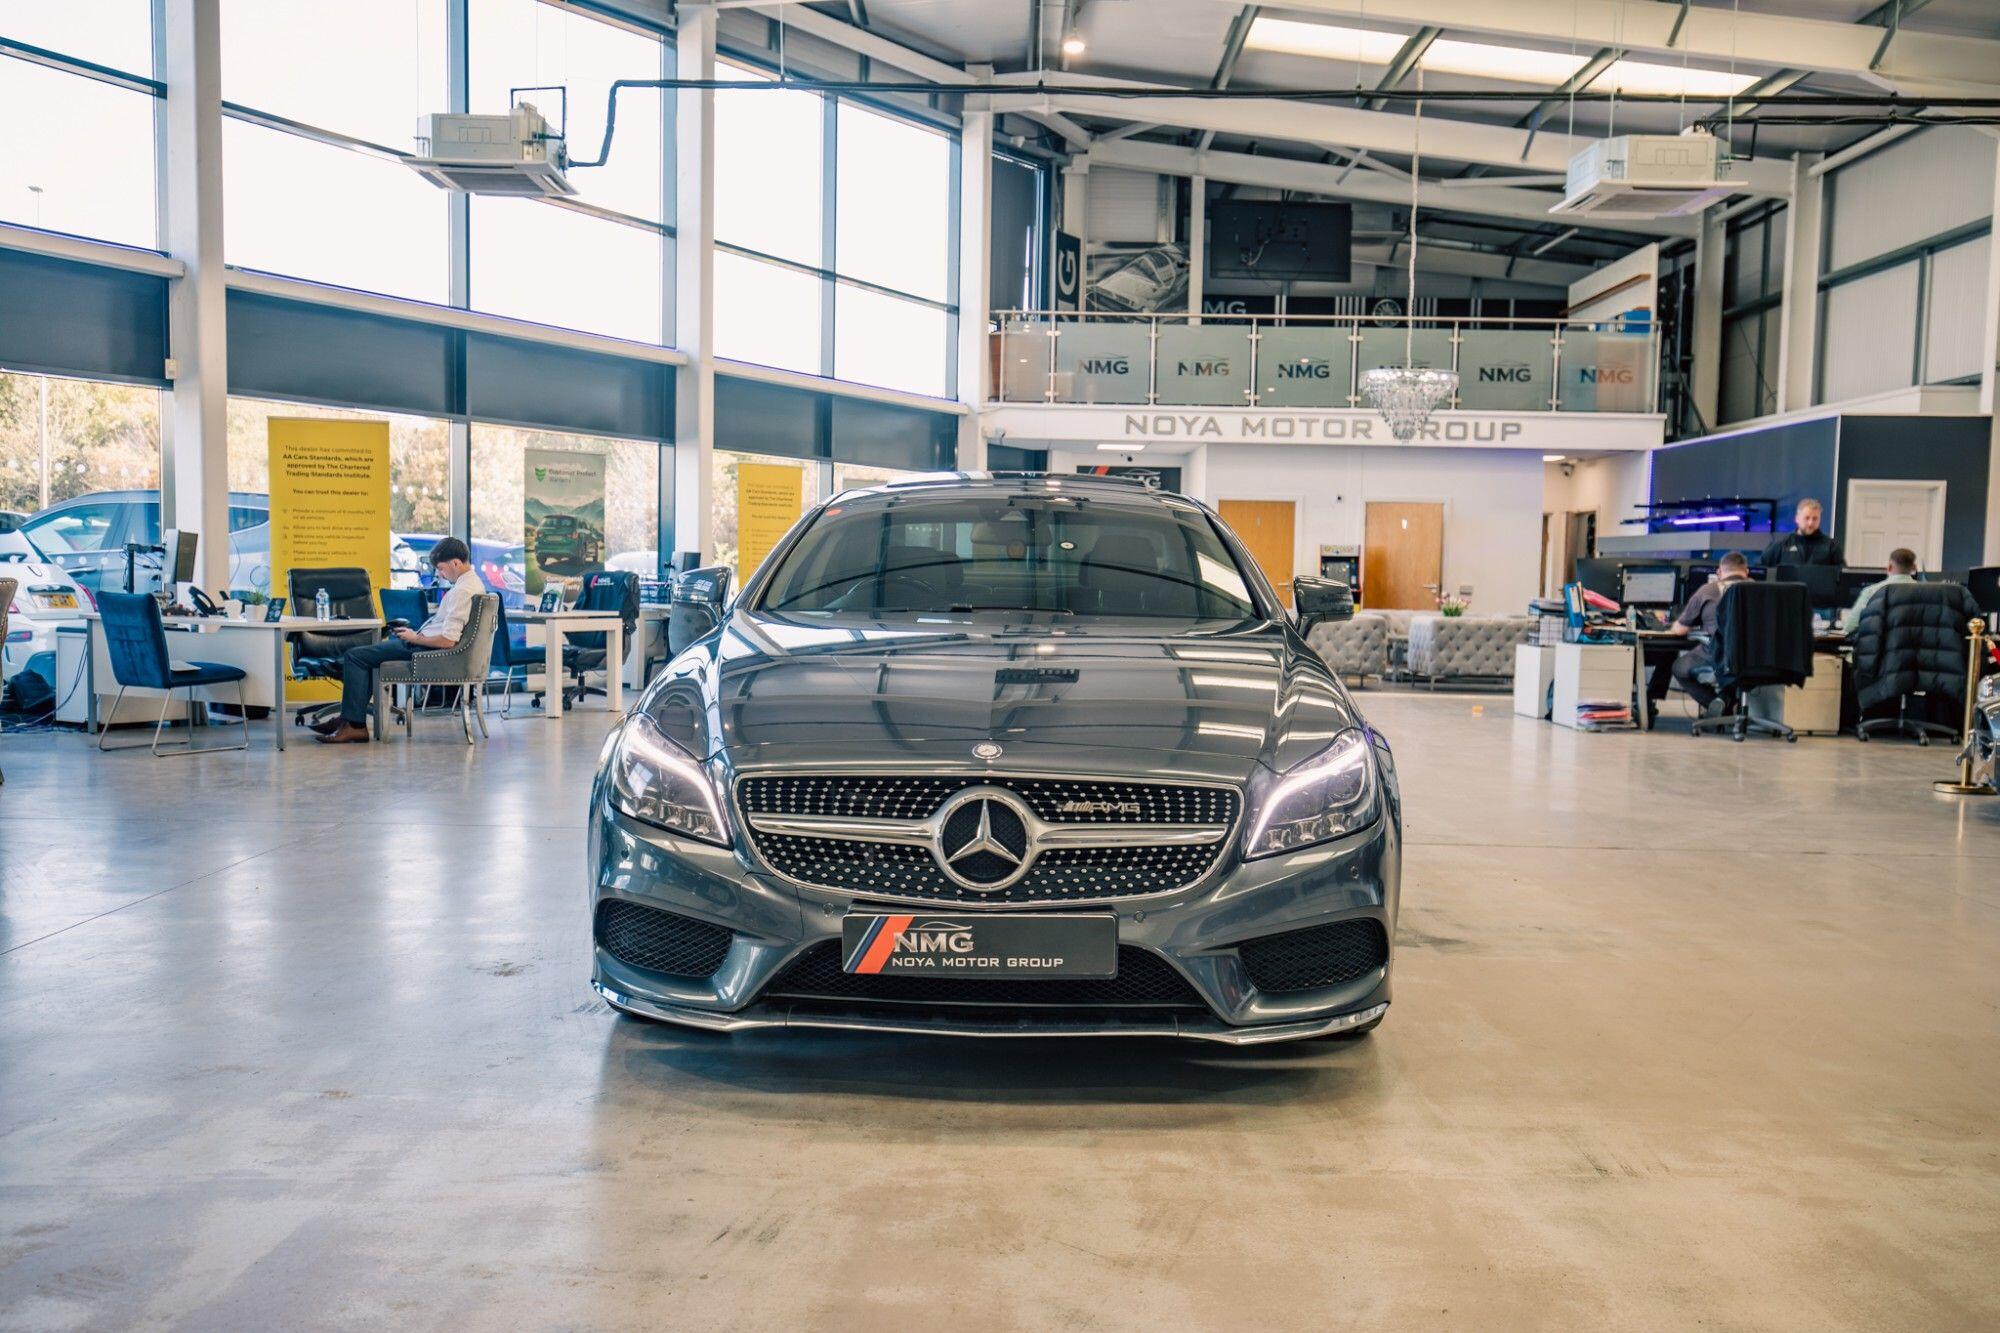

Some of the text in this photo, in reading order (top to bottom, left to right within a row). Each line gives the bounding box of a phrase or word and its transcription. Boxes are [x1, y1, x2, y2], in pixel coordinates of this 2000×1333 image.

[1078, 360, 1129, 375] NMG
[1178, 361, 1230, 376] NMG
[1278, 363, 1330, 379] NMG
[1479, 367, 1532, 382] NMG
[1580, 368, 1633, 384] NMG
[1125, 414, 1522, 442] NOYA MOTOR ROUP
[893, 931, 974, 953] NMG
[892, 957, 1064, 968] NOYA MOTOR GROUP
